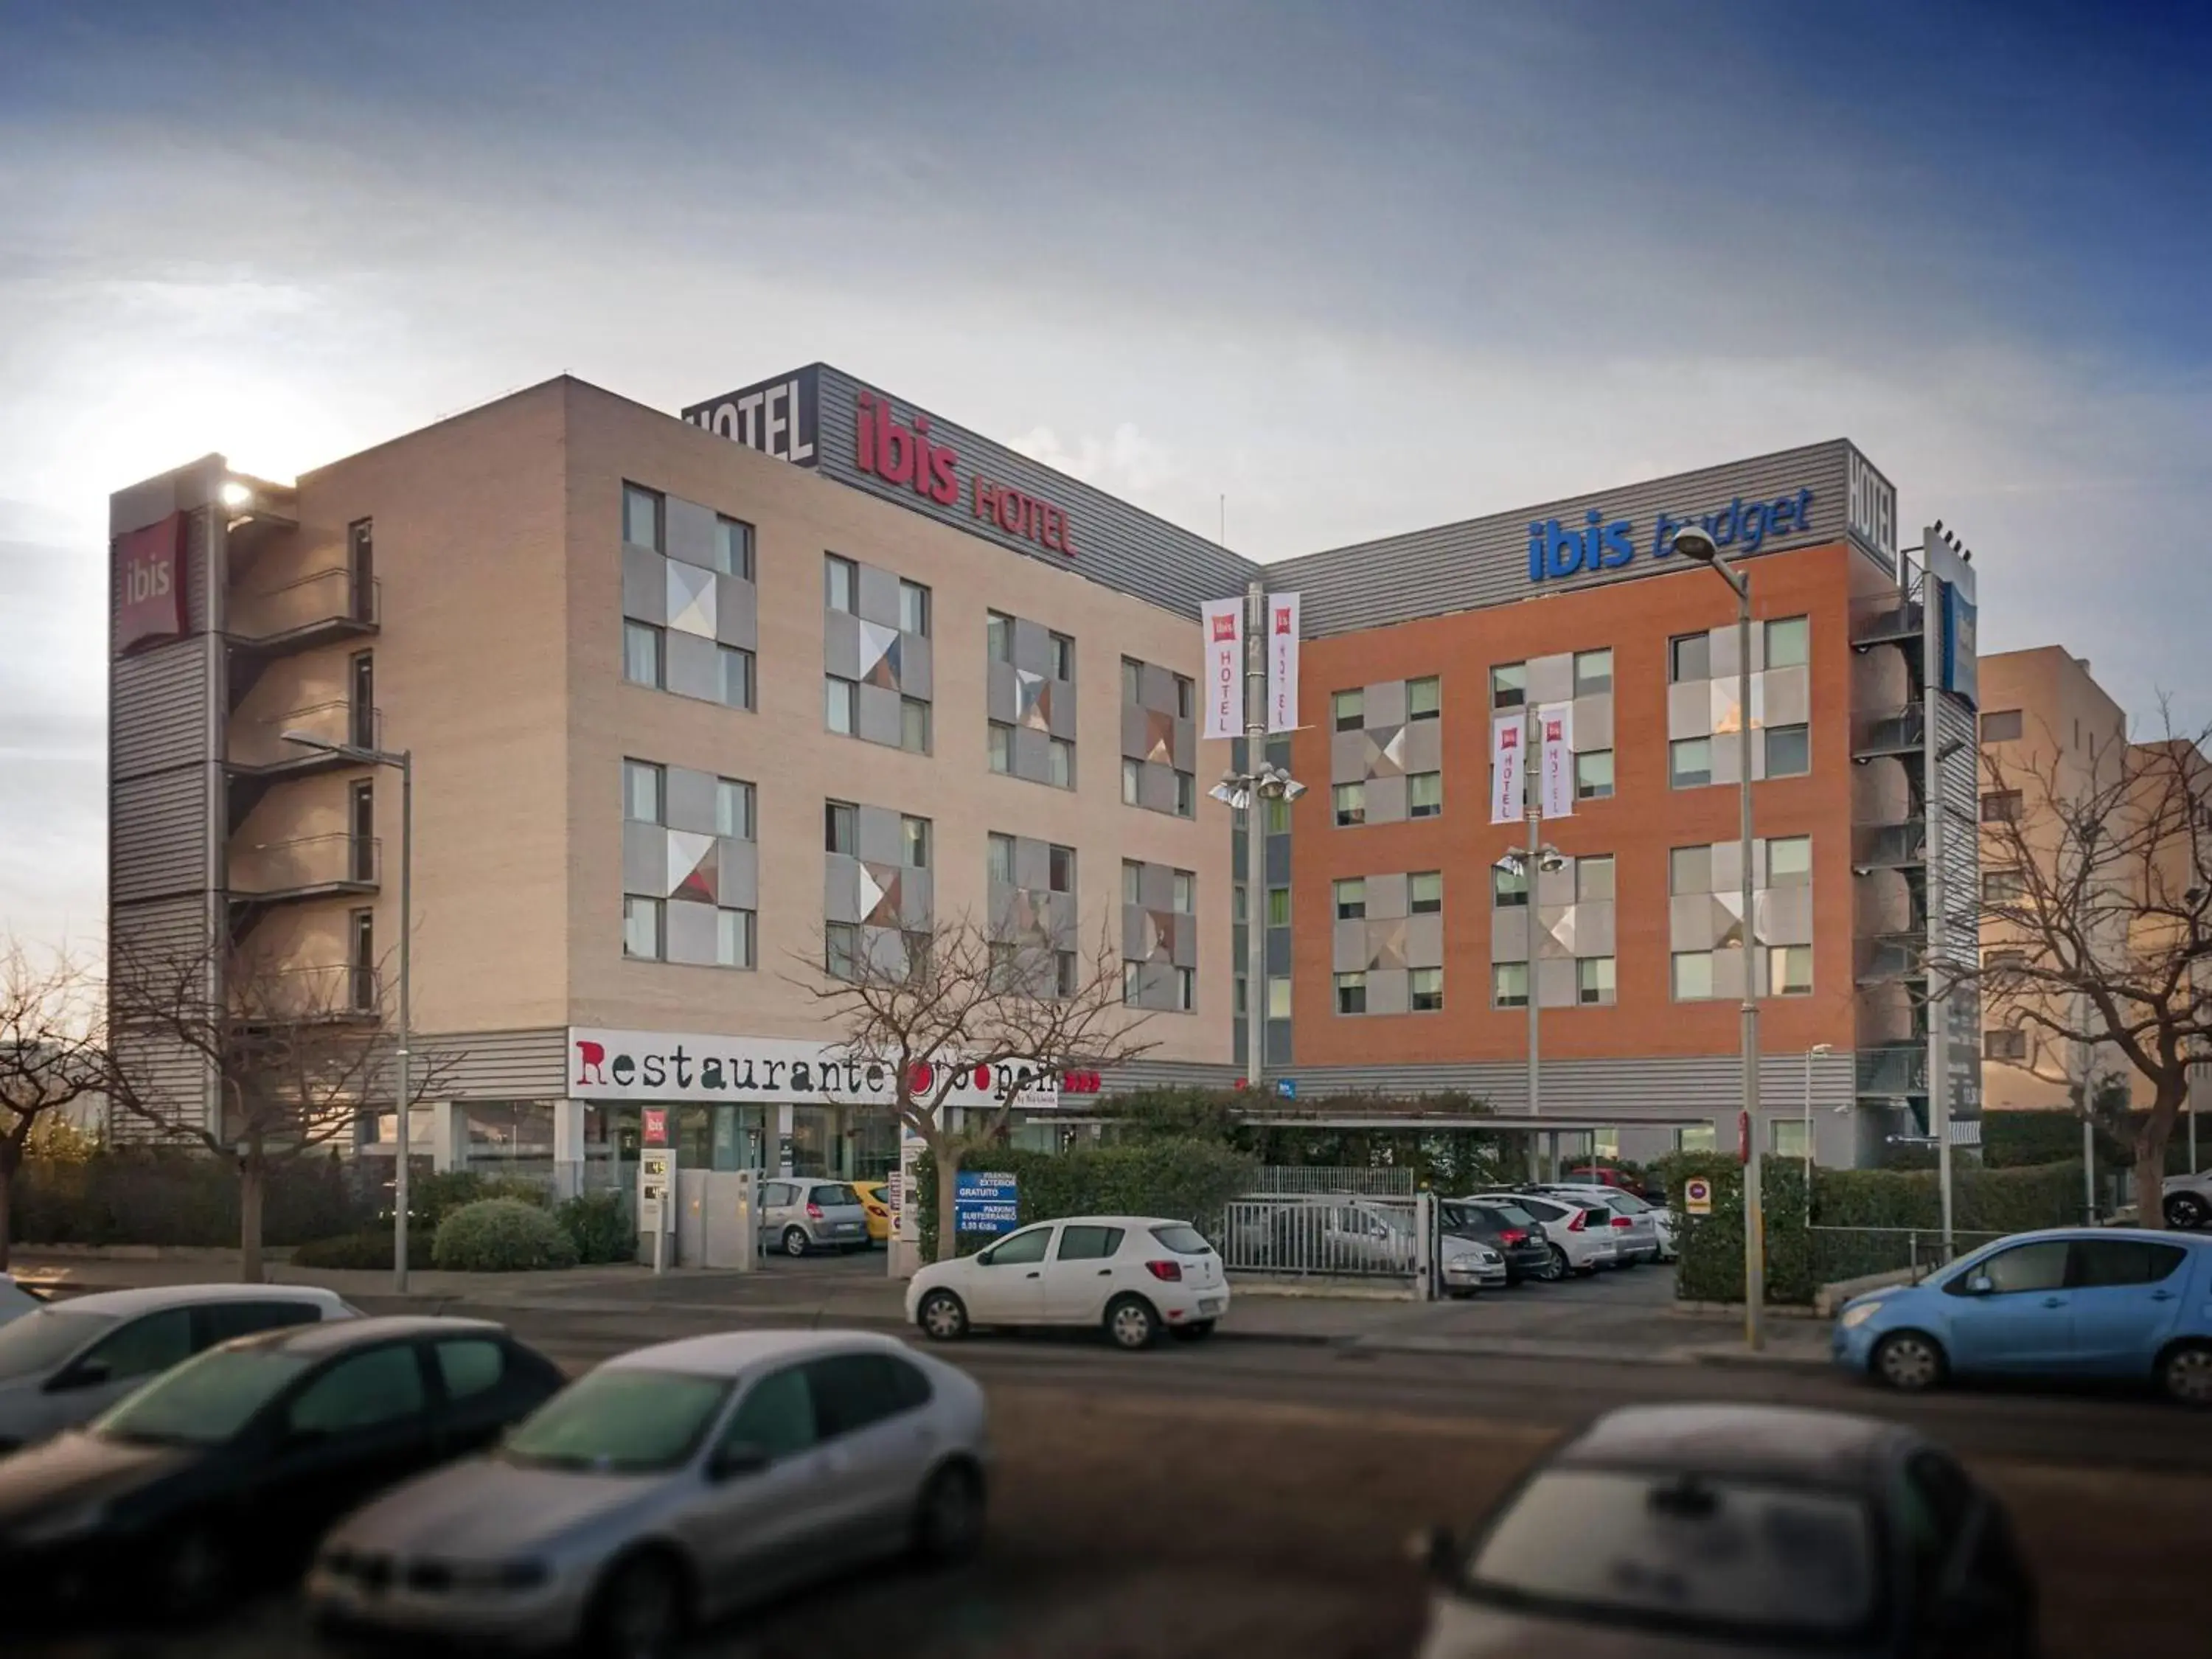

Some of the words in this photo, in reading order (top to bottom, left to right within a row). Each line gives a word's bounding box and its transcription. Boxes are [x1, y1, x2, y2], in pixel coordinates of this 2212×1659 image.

[684, 380, 814, 462] OTEL
[856, 390, 960, 507] ibis
[971, 473, 1079, 557] HOTEL
[1848, 447, 1896, 564] HOTEL
[1528, 507, 1635, 582] ibis
[1652, 487, 1815, 558] bdget
[127, 552, 170, 606] ibis
[1220, 650, 1231, 731] HOTEL
[1502, 754, 1512, 818] HOTEL
[576, 1040, 885, 1093] Restaurante
[959, 1187, 999, 1197] GRATUITO
[983, 1206, 1016, 1214] PARKING
